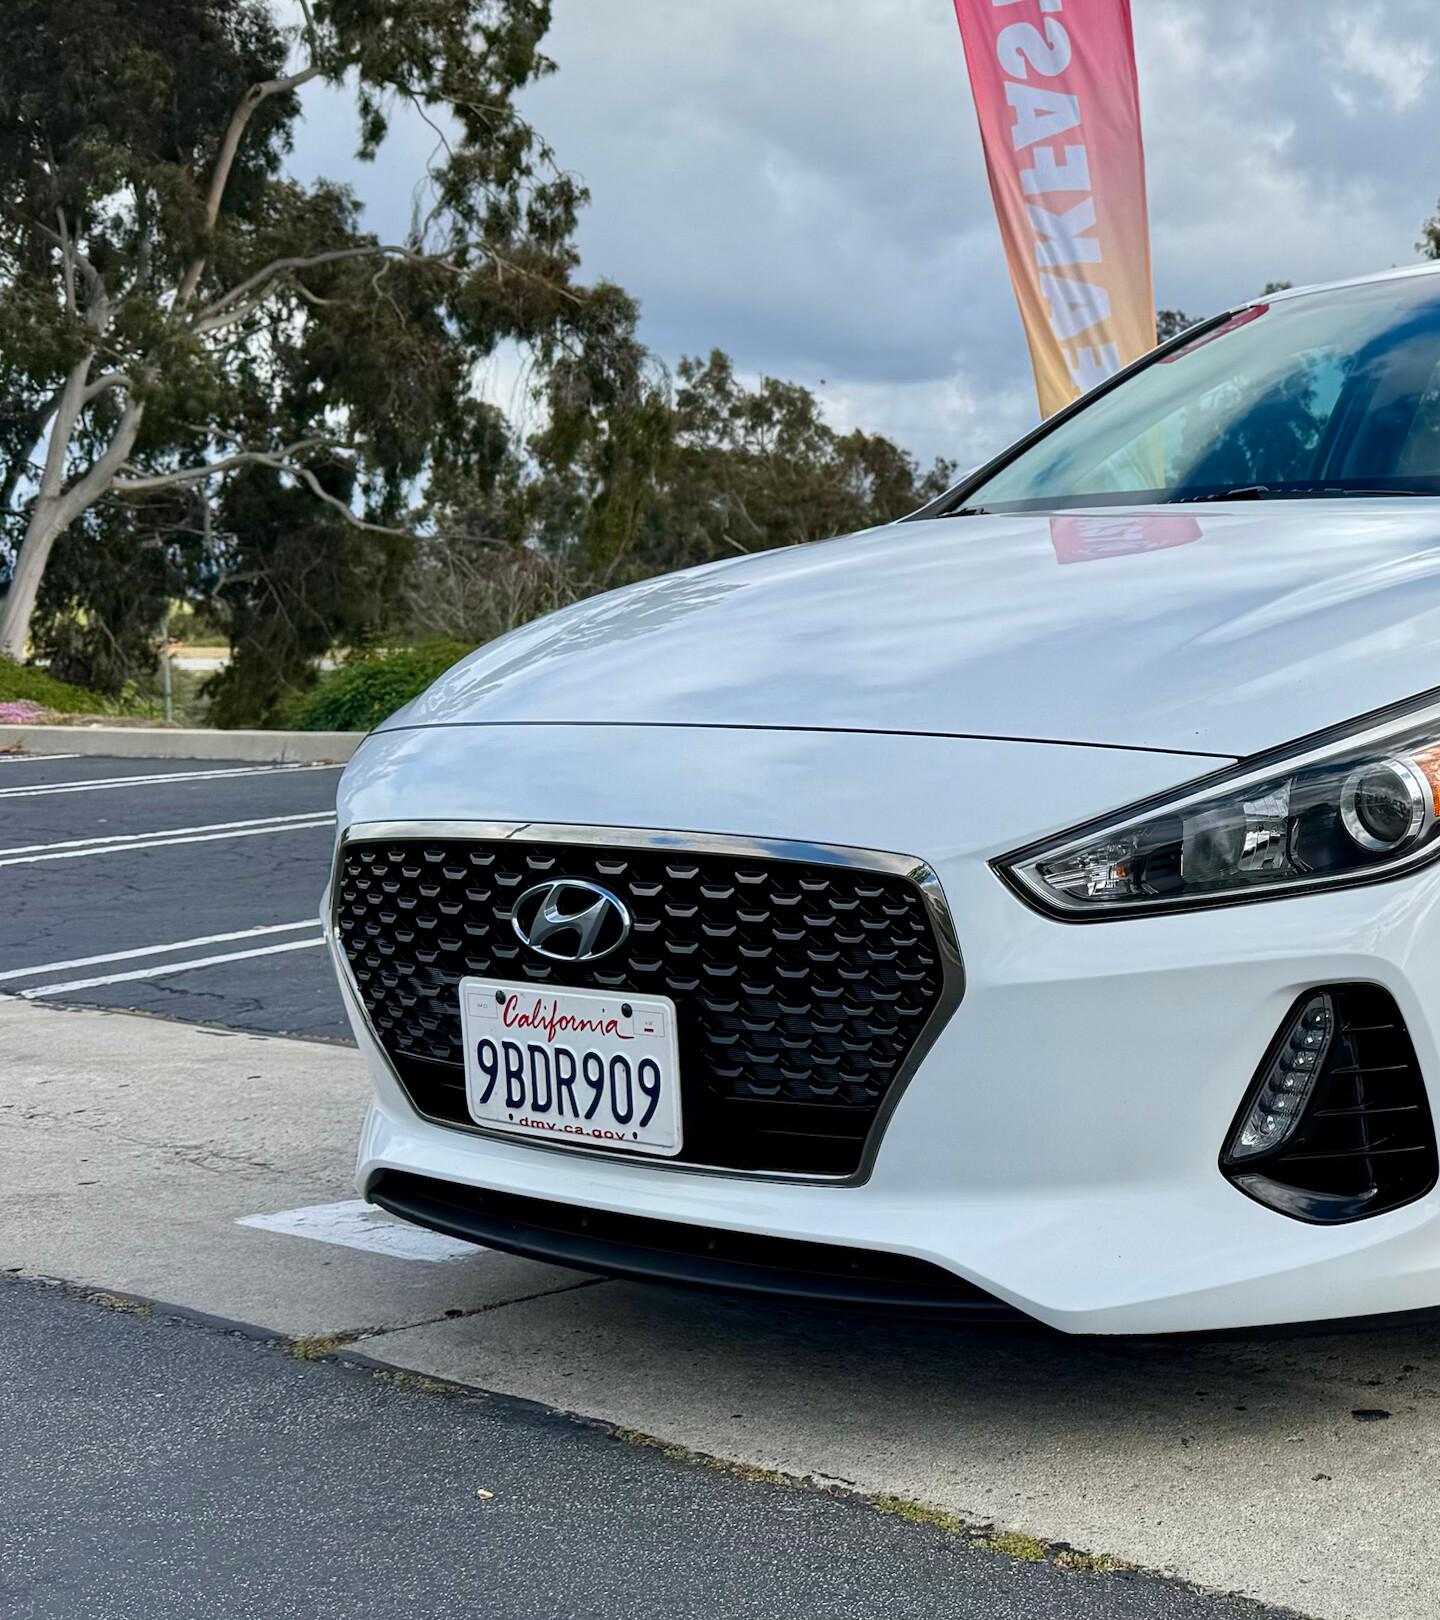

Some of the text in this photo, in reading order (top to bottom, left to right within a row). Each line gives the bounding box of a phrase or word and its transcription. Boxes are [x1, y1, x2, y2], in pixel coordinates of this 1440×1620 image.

[503, 994, 635, 1043] California
[477, 1038, 661, 1128] 9BDR909
[519, 1116, 626, 1141] dmv.ca.gov
